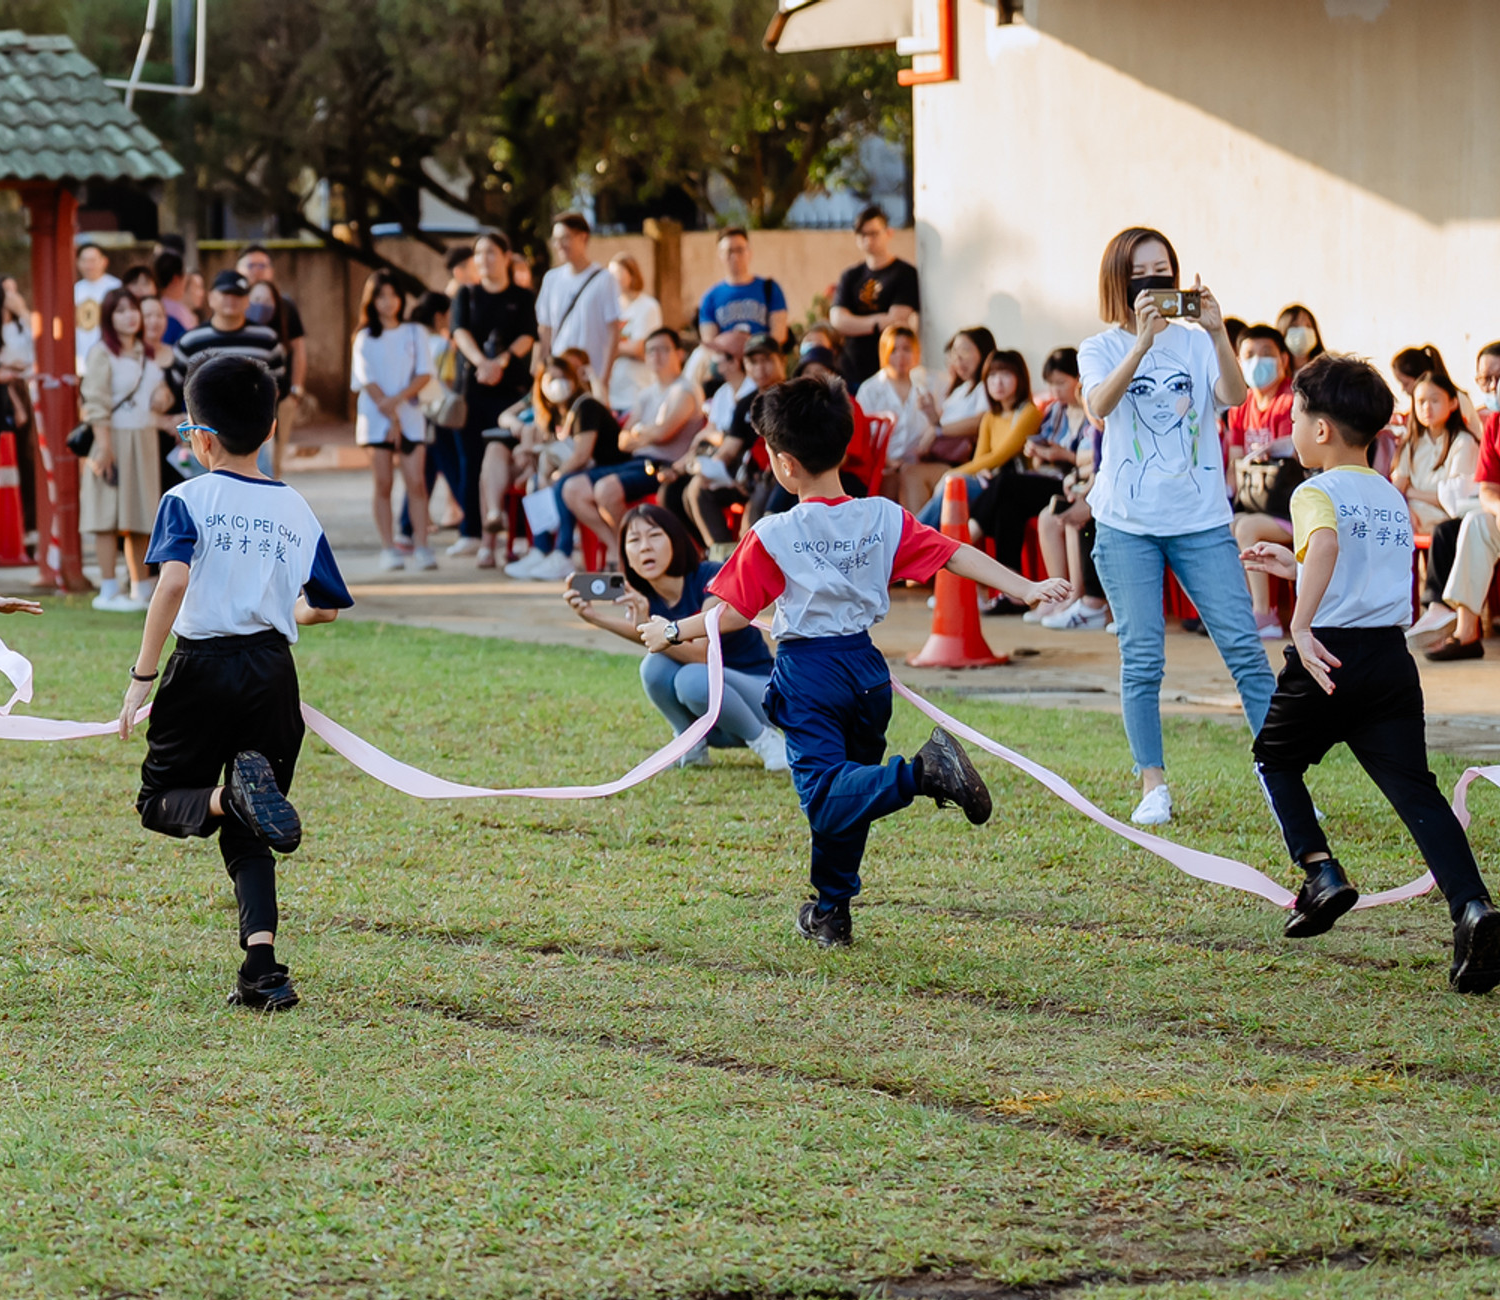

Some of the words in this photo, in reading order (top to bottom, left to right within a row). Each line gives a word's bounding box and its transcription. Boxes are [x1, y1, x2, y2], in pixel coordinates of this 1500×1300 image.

[1373, 508, 1392, 522] PEI
[205, 513, 227, 528] SJK
[230, 514, 249, 533] (C)
[253, 518, 275, 534] PEI
[277, 523, 302, 548] CHAI
[214, 532, 287, 564] 培才学校
[833, 539, 856, 552] PEI
